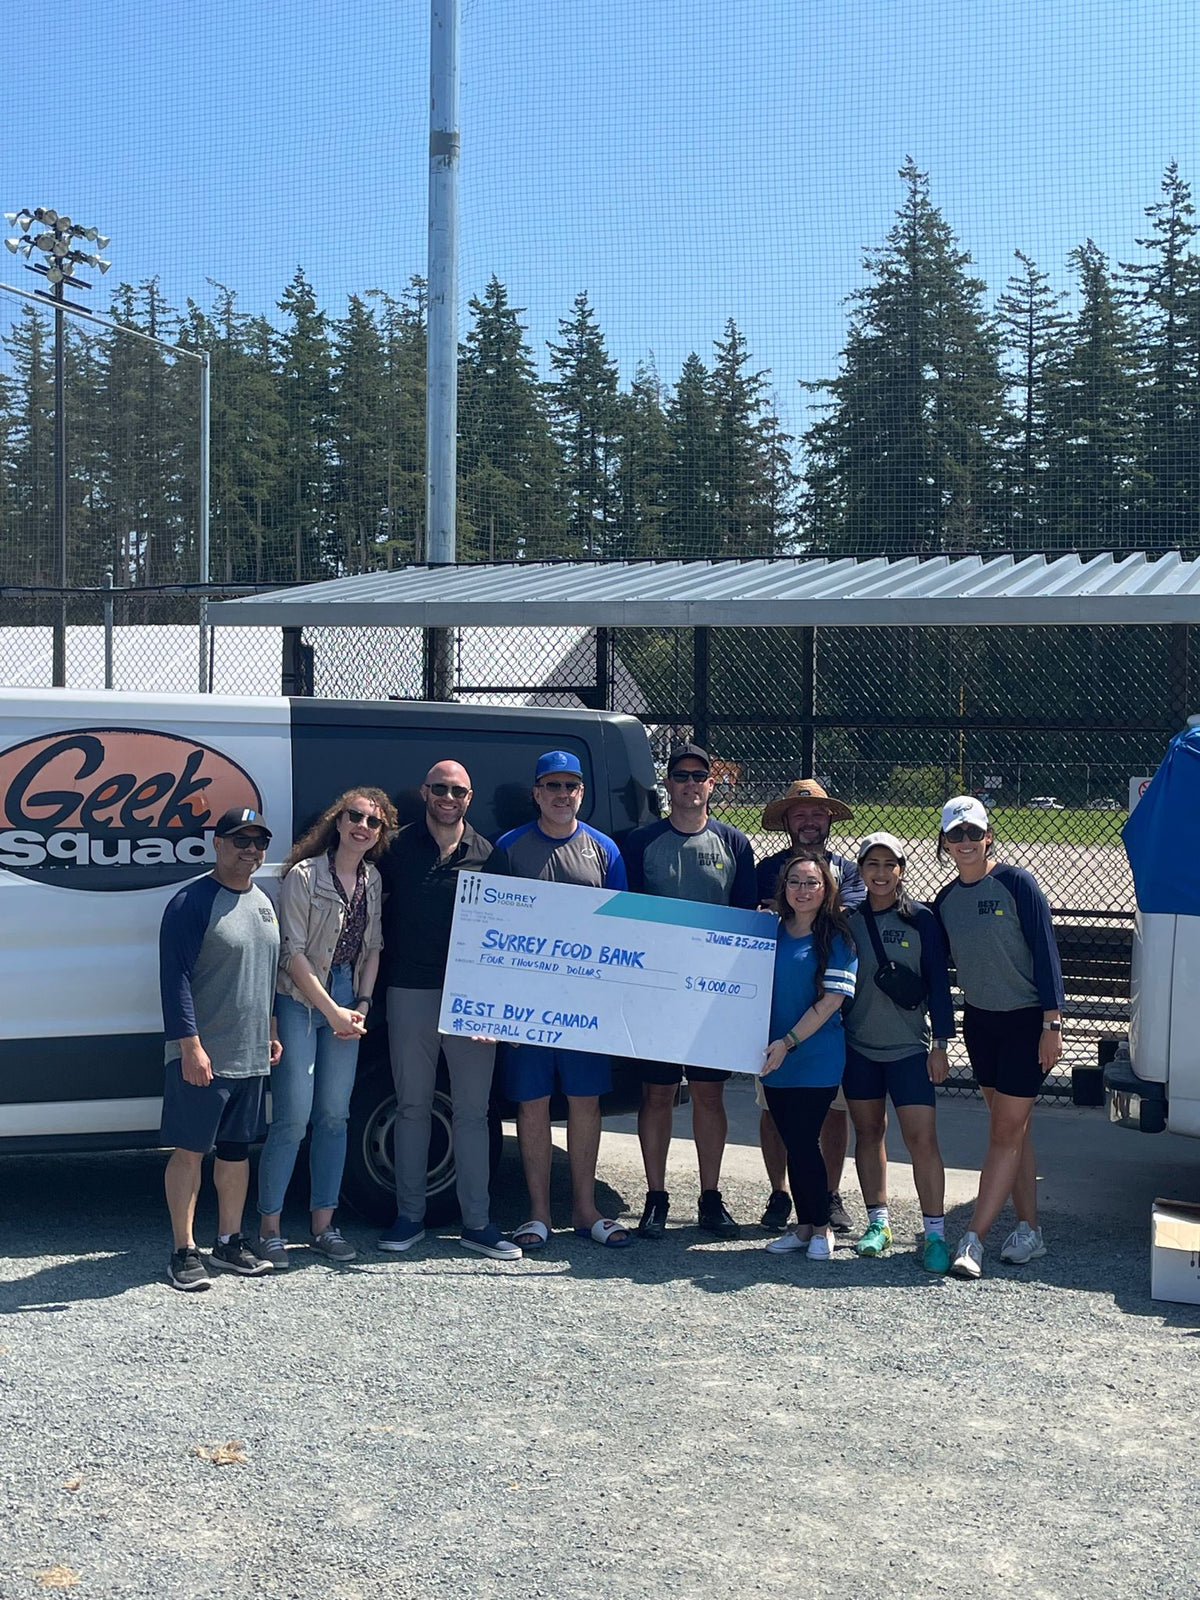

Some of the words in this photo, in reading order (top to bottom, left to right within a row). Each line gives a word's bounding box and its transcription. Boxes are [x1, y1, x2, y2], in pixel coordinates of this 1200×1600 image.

[5, 735, 212, 828] Geek
[0, 830, 217, 866] Squad
[698, 852, 720, 860] BEST
[699, 859, 718, 868] BUY
[483, 888, 537, 903] SURREY
[977, 900, 1000, 908] BEST
[978, 907, 997, 915] BUY
[706, 932, 734, 946] JUNE
[882, 930, 906, 938] BEST
[883, 936, 903, 944] BUY
[481, 929, 548, 954] SURREY
[551, 939, 592, 960] FOOD
[599, 946, 646, 969] BANK
[480, 954, 505, 965] FOUR
[511, 957, 560, 972] THOUSAND
[451, 997, 495, 1017] BEST
[503, 1004, 535, 1022] BUY
[542, 1011, 599, 1030] CANADA
[526, 1028, 563, 1044] CITY
